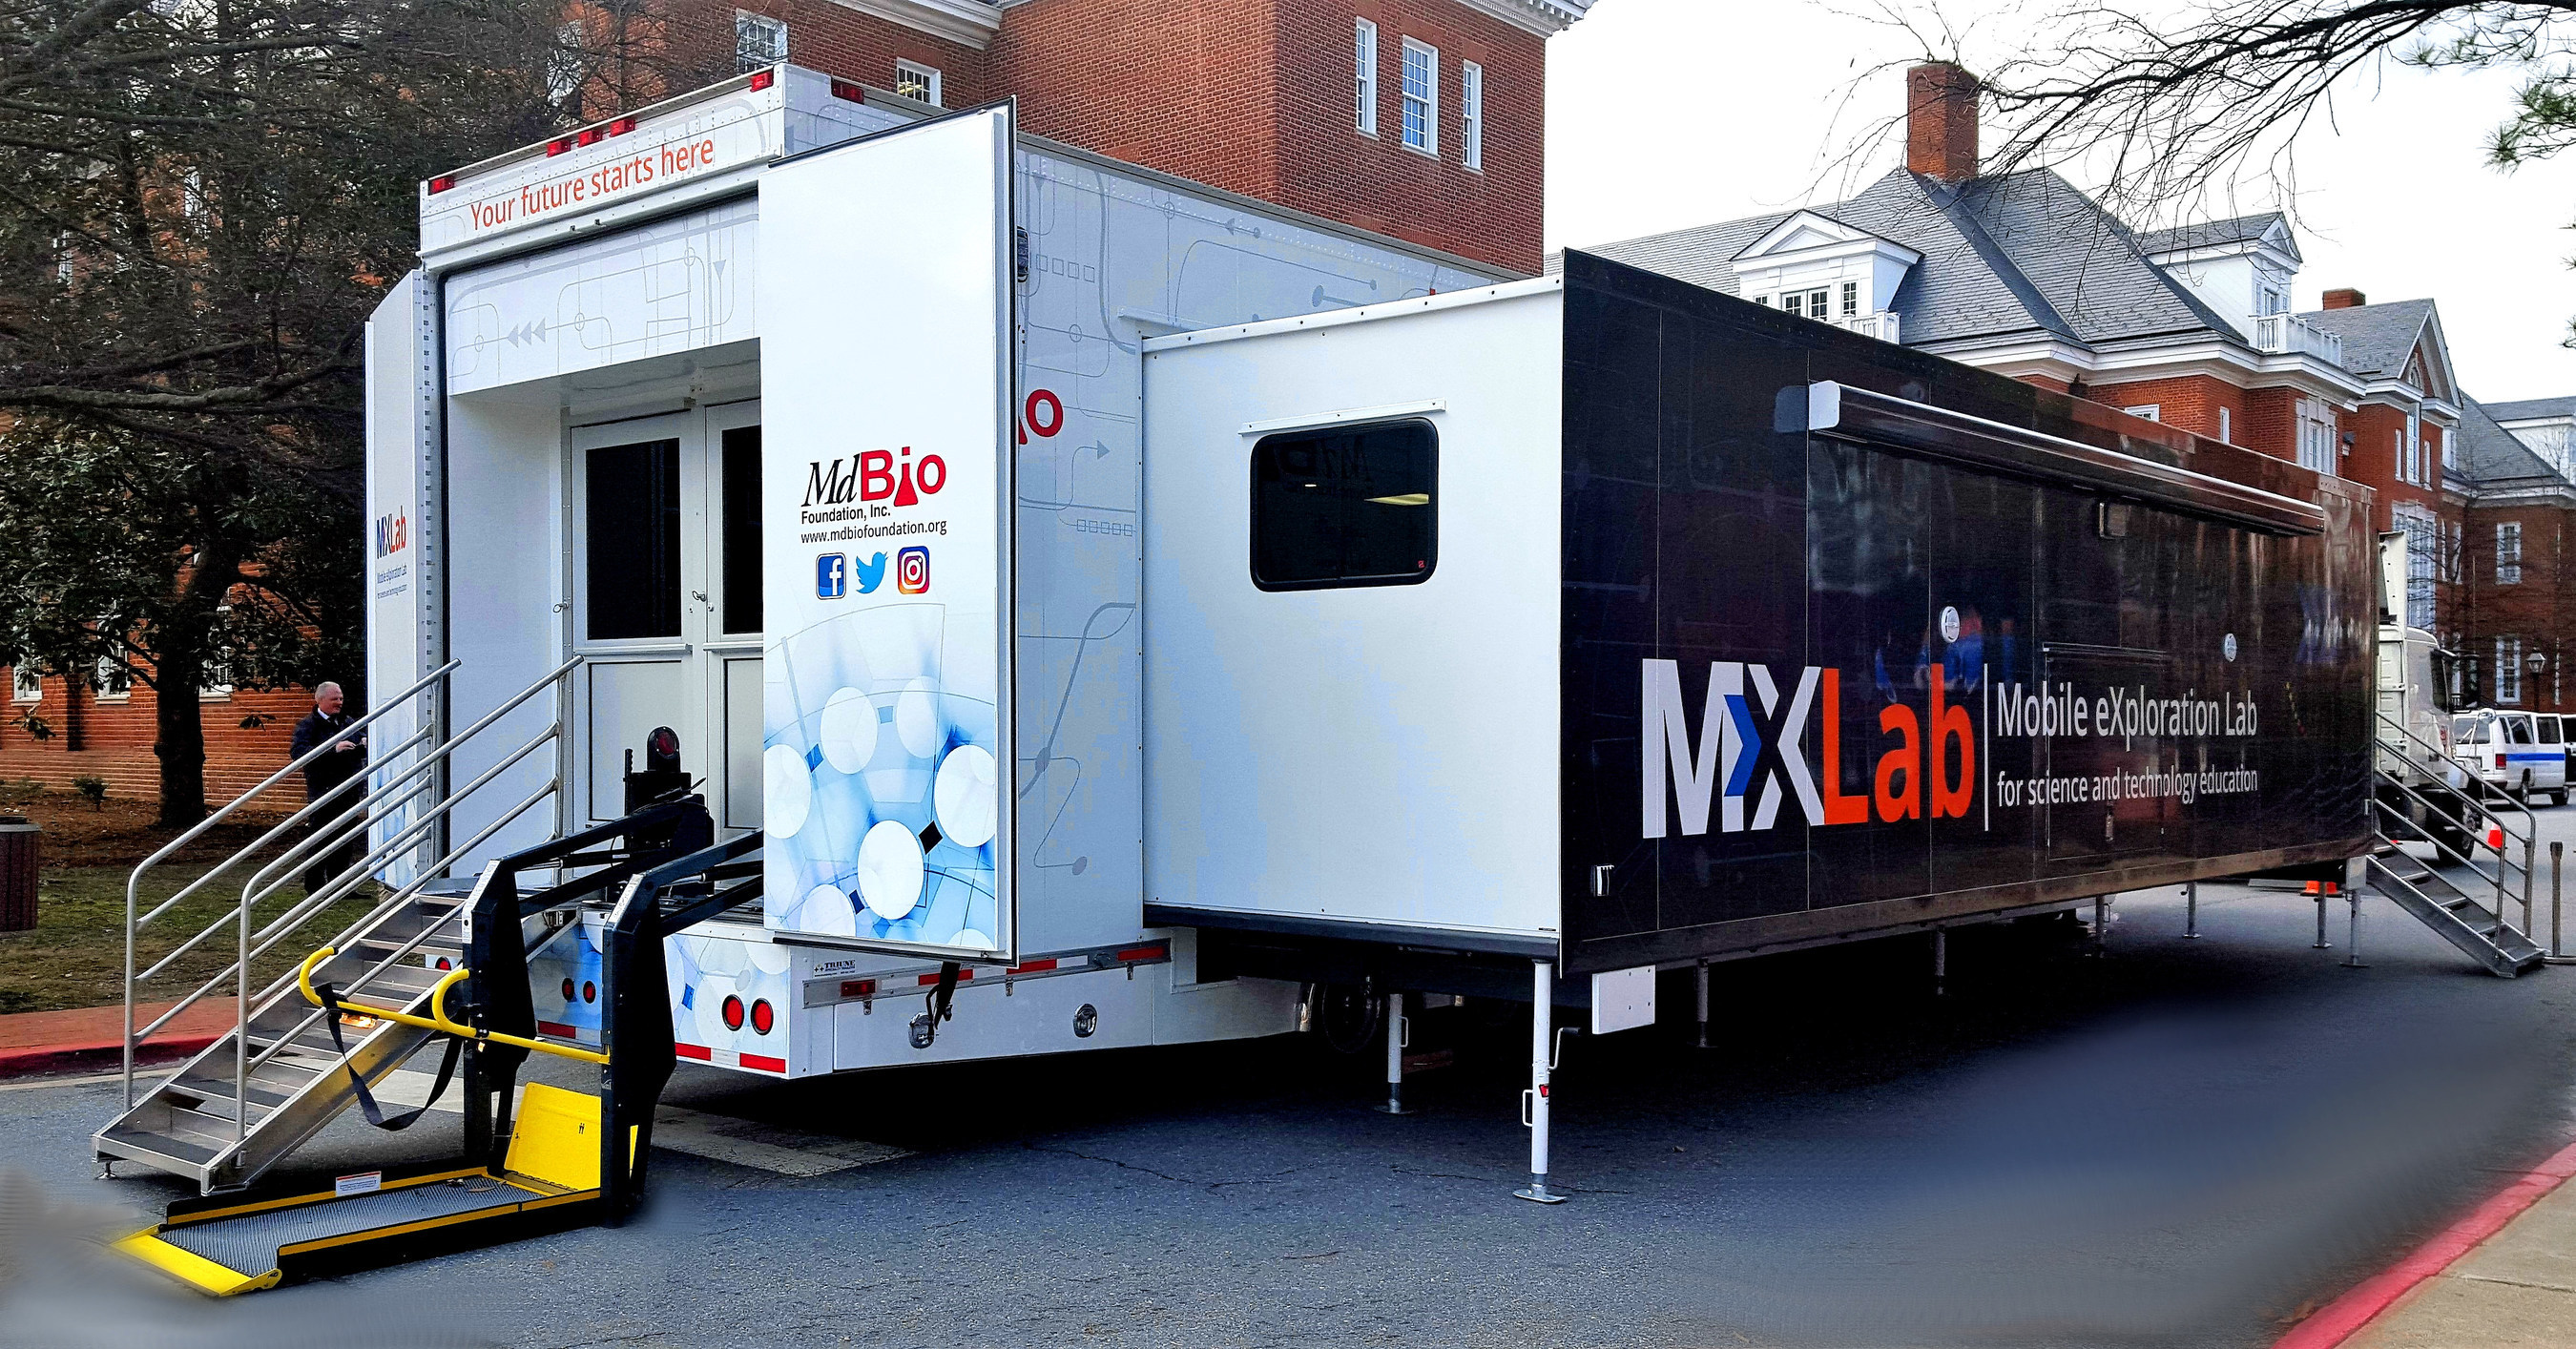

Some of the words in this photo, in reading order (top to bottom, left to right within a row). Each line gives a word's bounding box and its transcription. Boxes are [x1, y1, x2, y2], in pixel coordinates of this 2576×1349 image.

[470, 197, 516, 231] Your
[521, 176, 585, 218] future
[592, 156, 654, 197] starts
[661, 138, 714, 176] here
[800, 446, 946, 507] MdBio
[377, 505, 406, 559] MXLab
[800, 506, 866, 525] Foundation,
[870, 504, 891, 519] Inc.
[800, 520, 947, 544] www.mdbiofoundation.org
[1997, 680, 2088, 737] Mobile
[2095, 684, 2219, 752] eXploration
[2226, 690, 2258, 737] Lab
[1642, 657, 1975, 840] MXLab
[1997, 771, 2024, 807] for
[2027, 770, 2088, 806] science
[2092, 766, 2120, 801] and
[2124, 764, 2197, 805] technology
[2199, 764, 2258, 794] education
